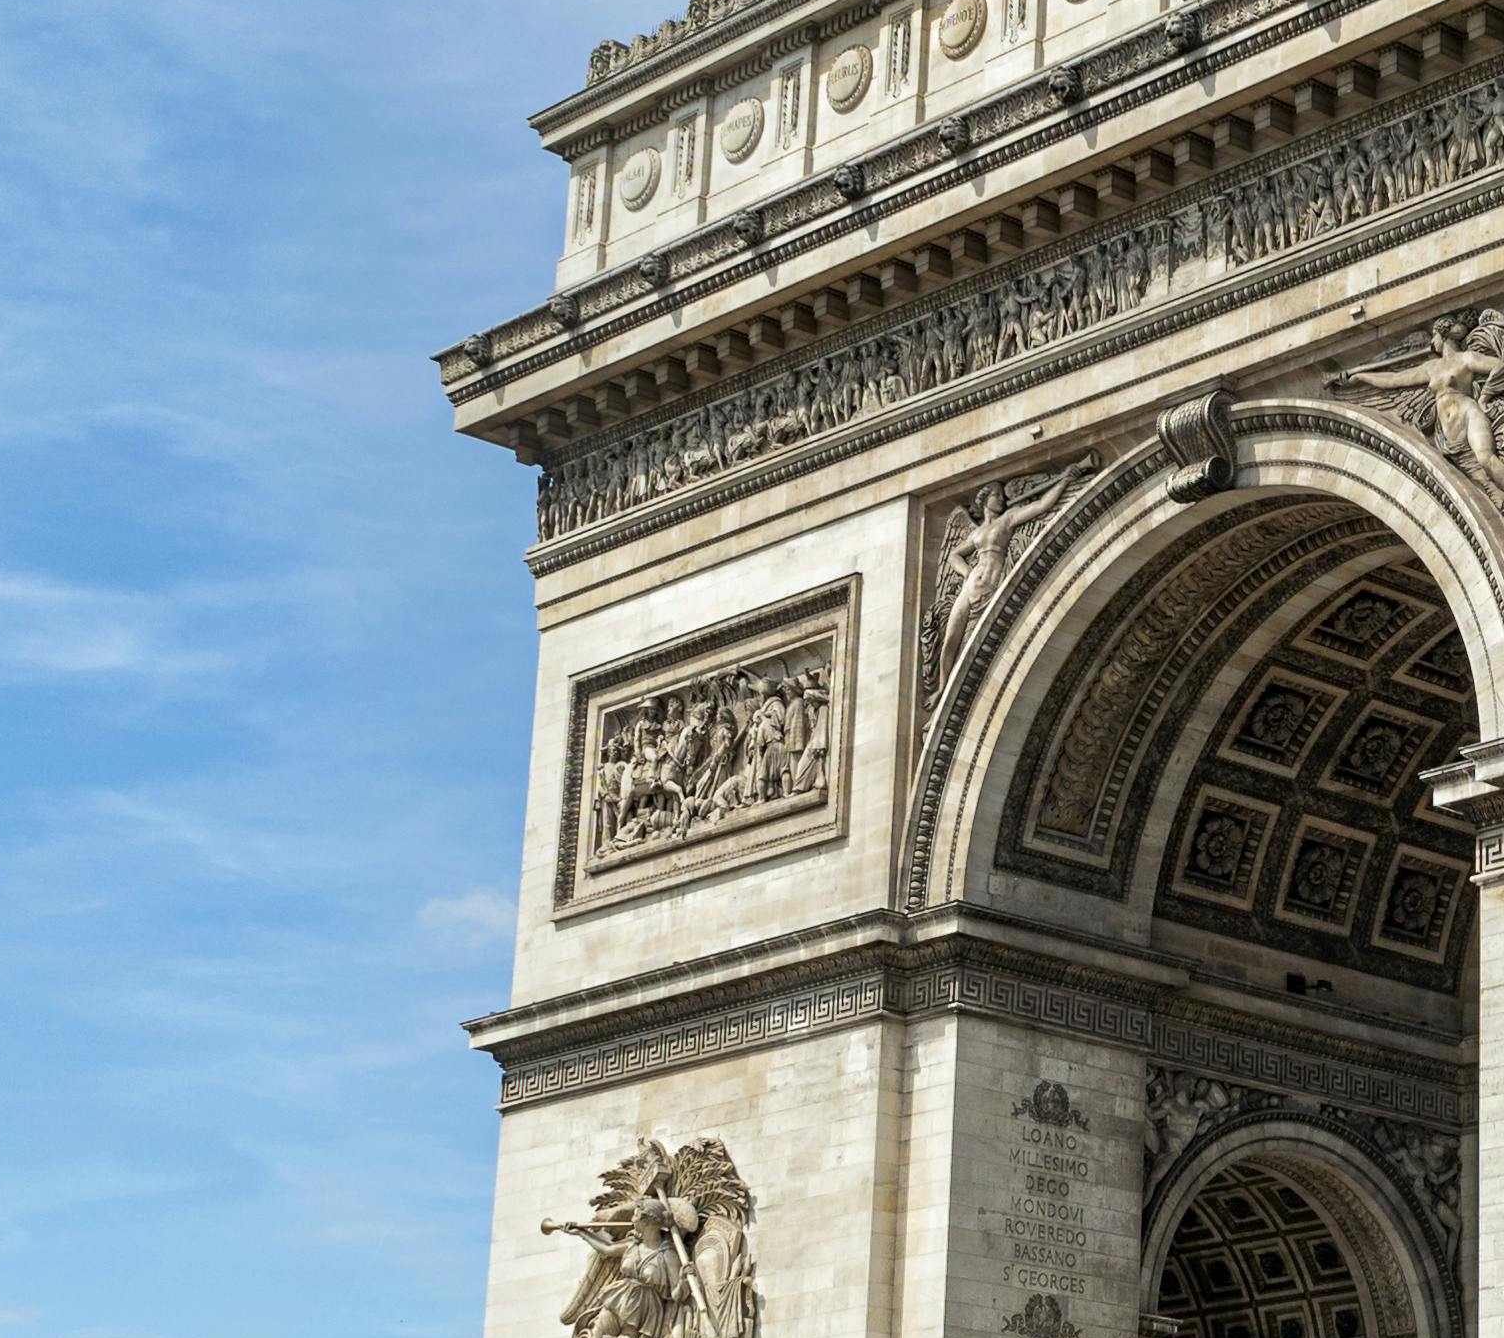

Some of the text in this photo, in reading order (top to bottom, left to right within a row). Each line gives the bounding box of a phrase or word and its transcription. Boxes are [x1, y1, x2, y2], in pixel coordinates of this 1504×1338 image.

[1022, 1126, 1077, 1151] LOANO
[1009, 1148, 1088, 1177] MILLESIMO
[1025, 1175, 1070, 1197] DEGO
[1010, 1196, 1084, 1224] MONDOVI
[1004, 1218, 1087, 1247] ROVEREDO
[1014, 1243, 1077, 1268] BASSANO
[1018, 1268, 1086, 1294] GEORGES
